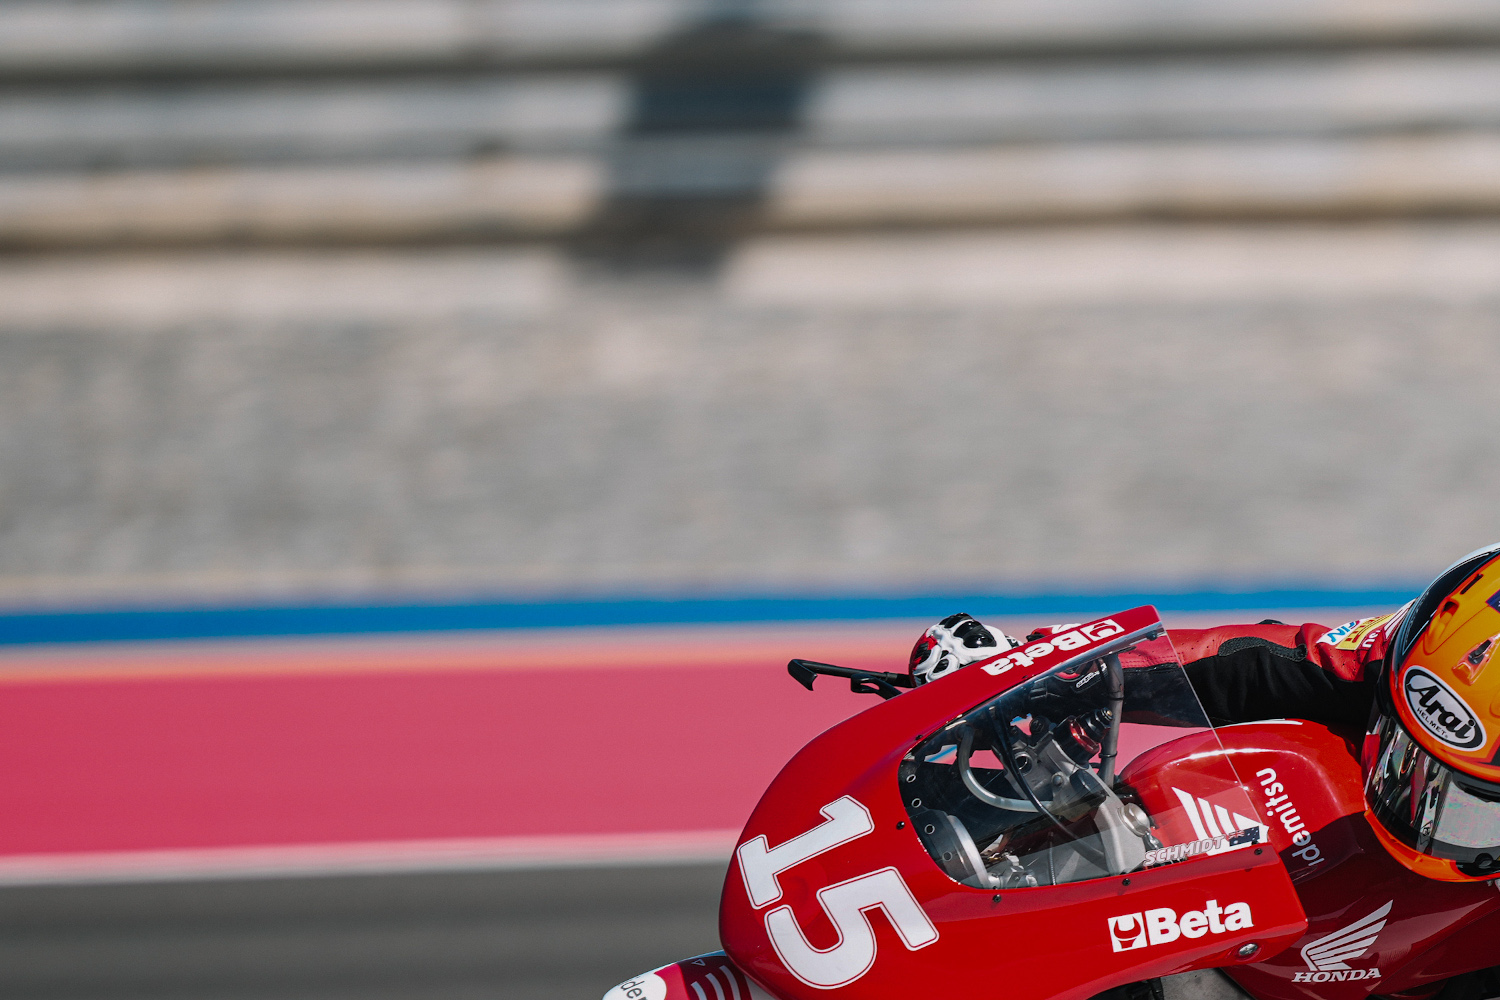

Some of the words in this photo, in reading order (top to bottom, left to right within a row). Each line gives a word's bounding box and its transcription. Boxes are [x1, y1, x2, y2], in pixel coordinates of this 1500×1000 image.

[980, 630, 1091, 676] Beta
[1406, 681, 1475, 739] Arai
[1255, 767, 1325, 867] idemitsu
[1142, 835, 1226, 867] SCHMIDT
[737, 795, 939, 989] 15
[1149, 900, 1254, 945] Beta
[1291, 967, 1382, 983] HONDA
